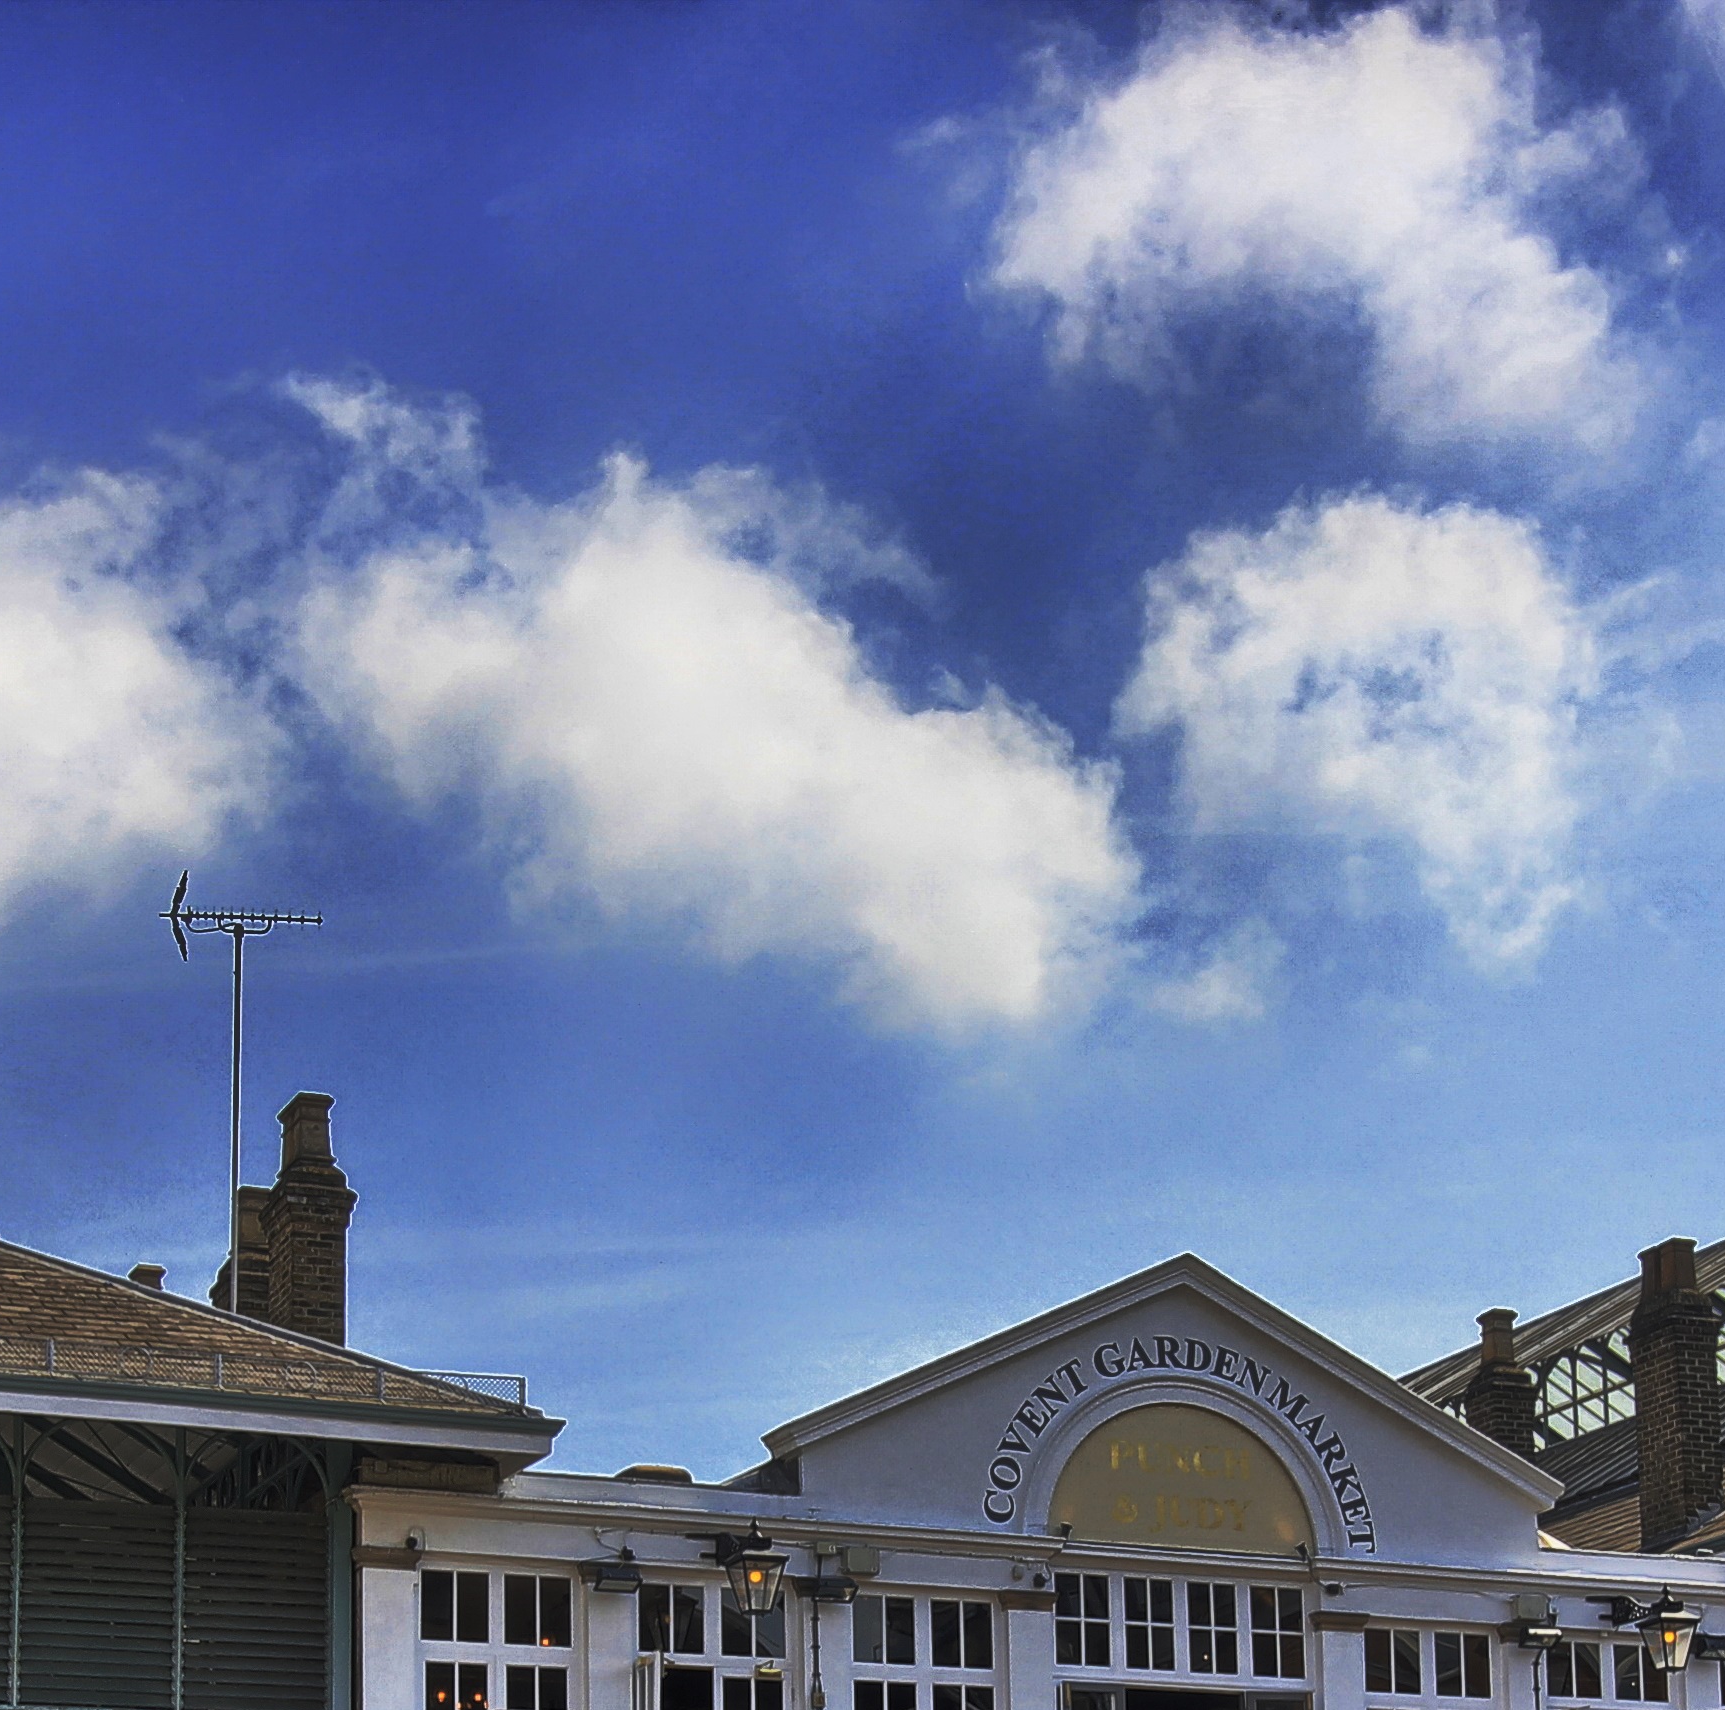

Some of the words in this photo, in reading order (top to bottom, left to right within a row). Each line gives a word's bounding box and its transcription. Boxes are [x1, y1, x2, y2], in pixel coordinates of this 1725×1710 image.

[982, 1358, 1089, 1525] COVENT
[1092, 1334, 1272, 1397] GARDEN
[1264, 1376, 1378, 1556] MARKET
[1110, 1440, 1251, 1481] PUNCH
[1112, 1493, 1139, 1525] &
[1150, 1494, 1252, 1531] JUDY
